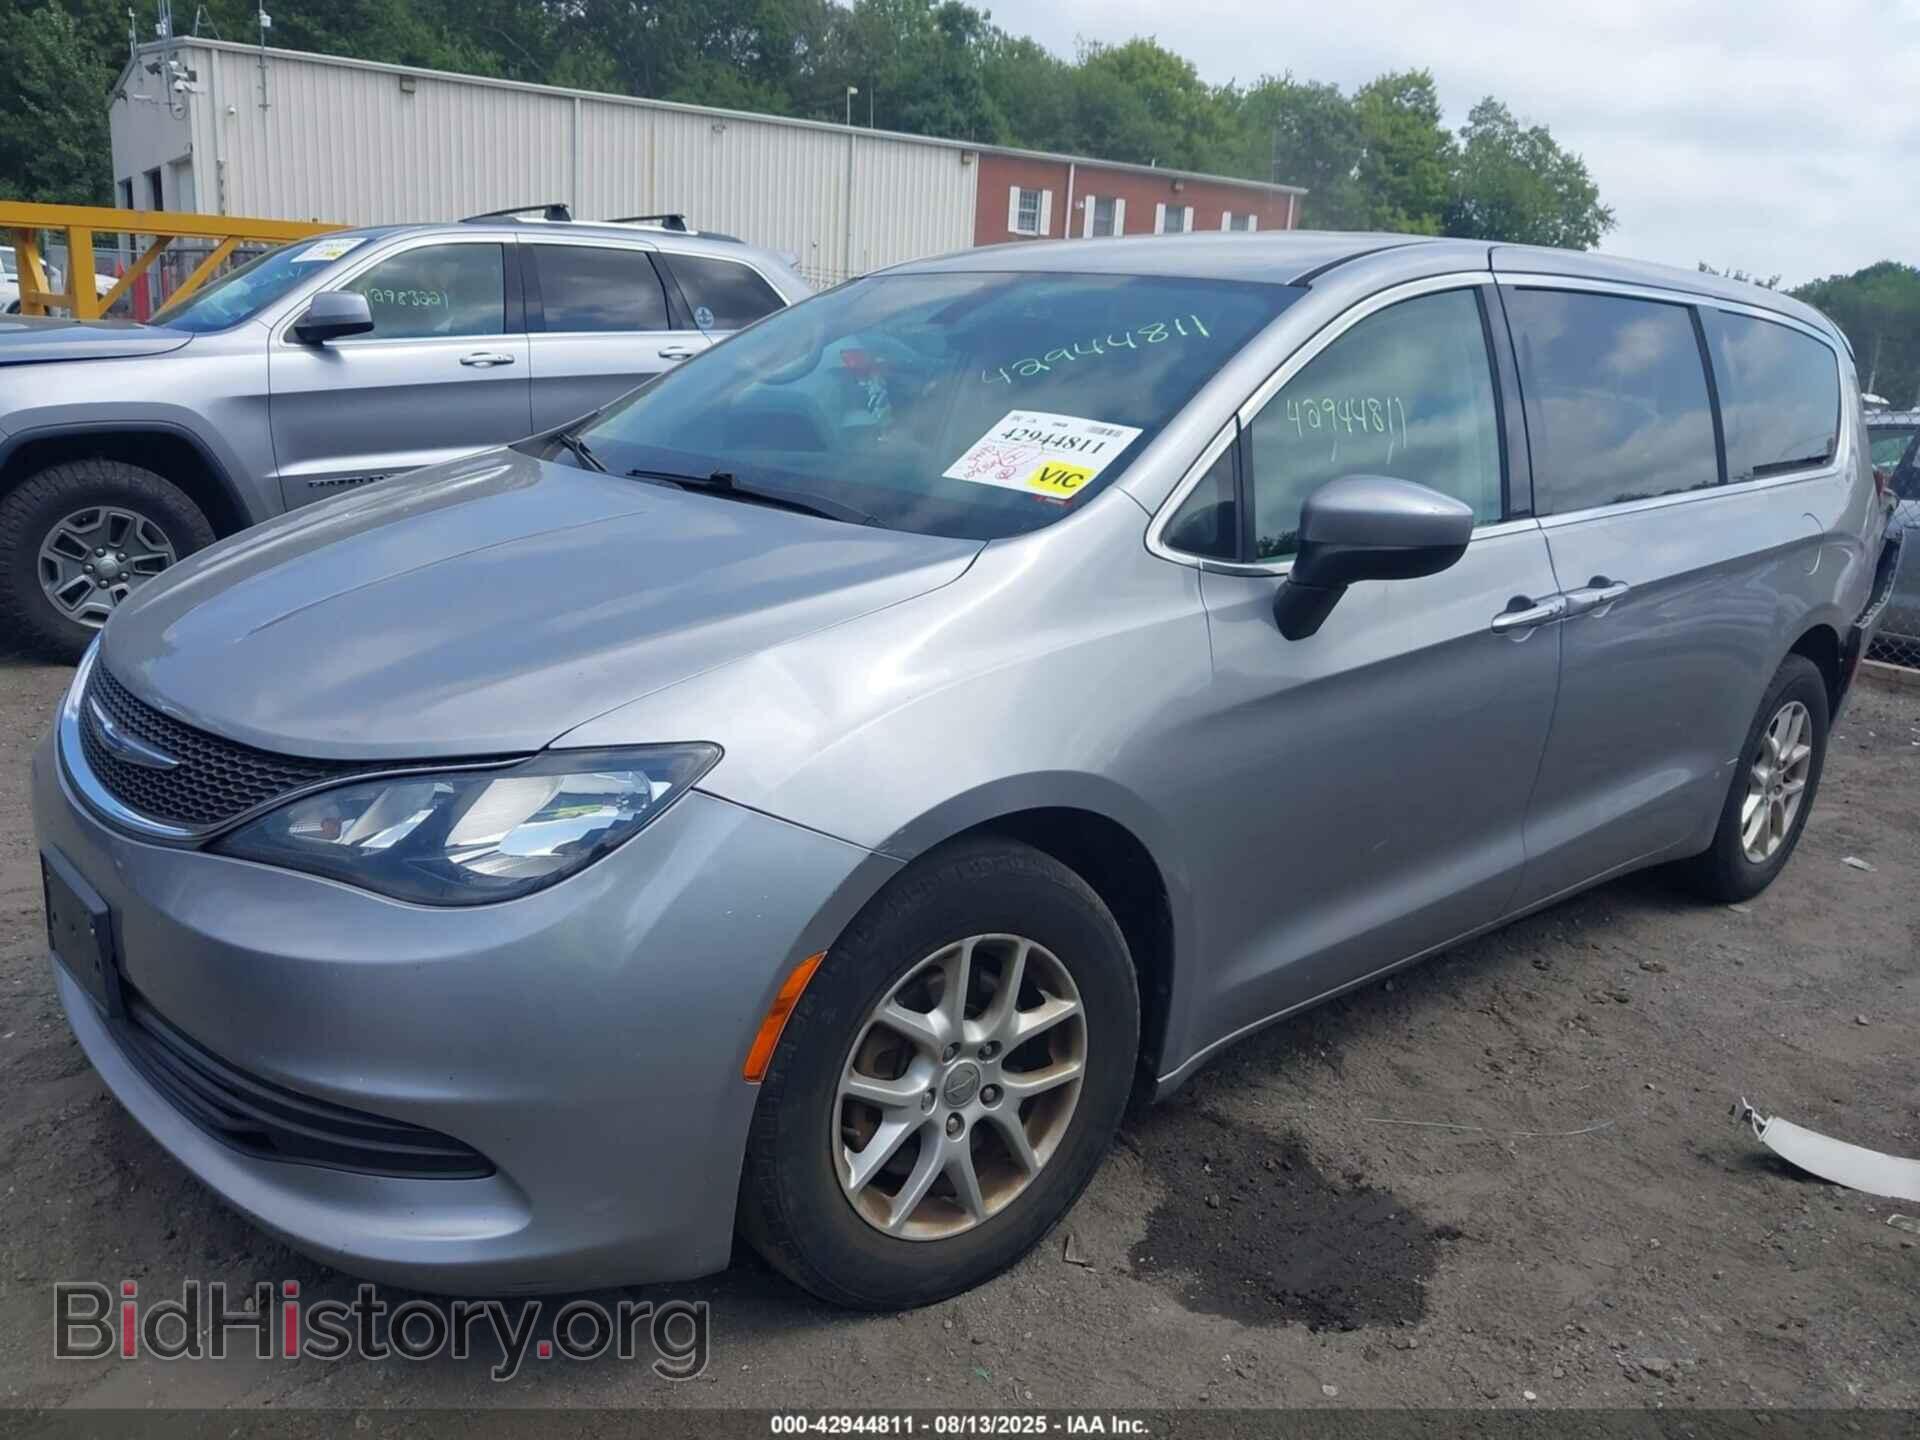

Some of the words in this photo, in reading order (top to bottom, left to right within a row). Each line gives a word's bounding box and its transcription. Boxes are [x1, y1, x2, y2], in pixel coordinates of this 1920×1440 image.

[982, 315, 1210, 384] 42944811
[1001, 427, 1106, 454] 42944811
[1287, 397, 1407, 449] 42944811
[1039, 466, 1084, 488] VIC
